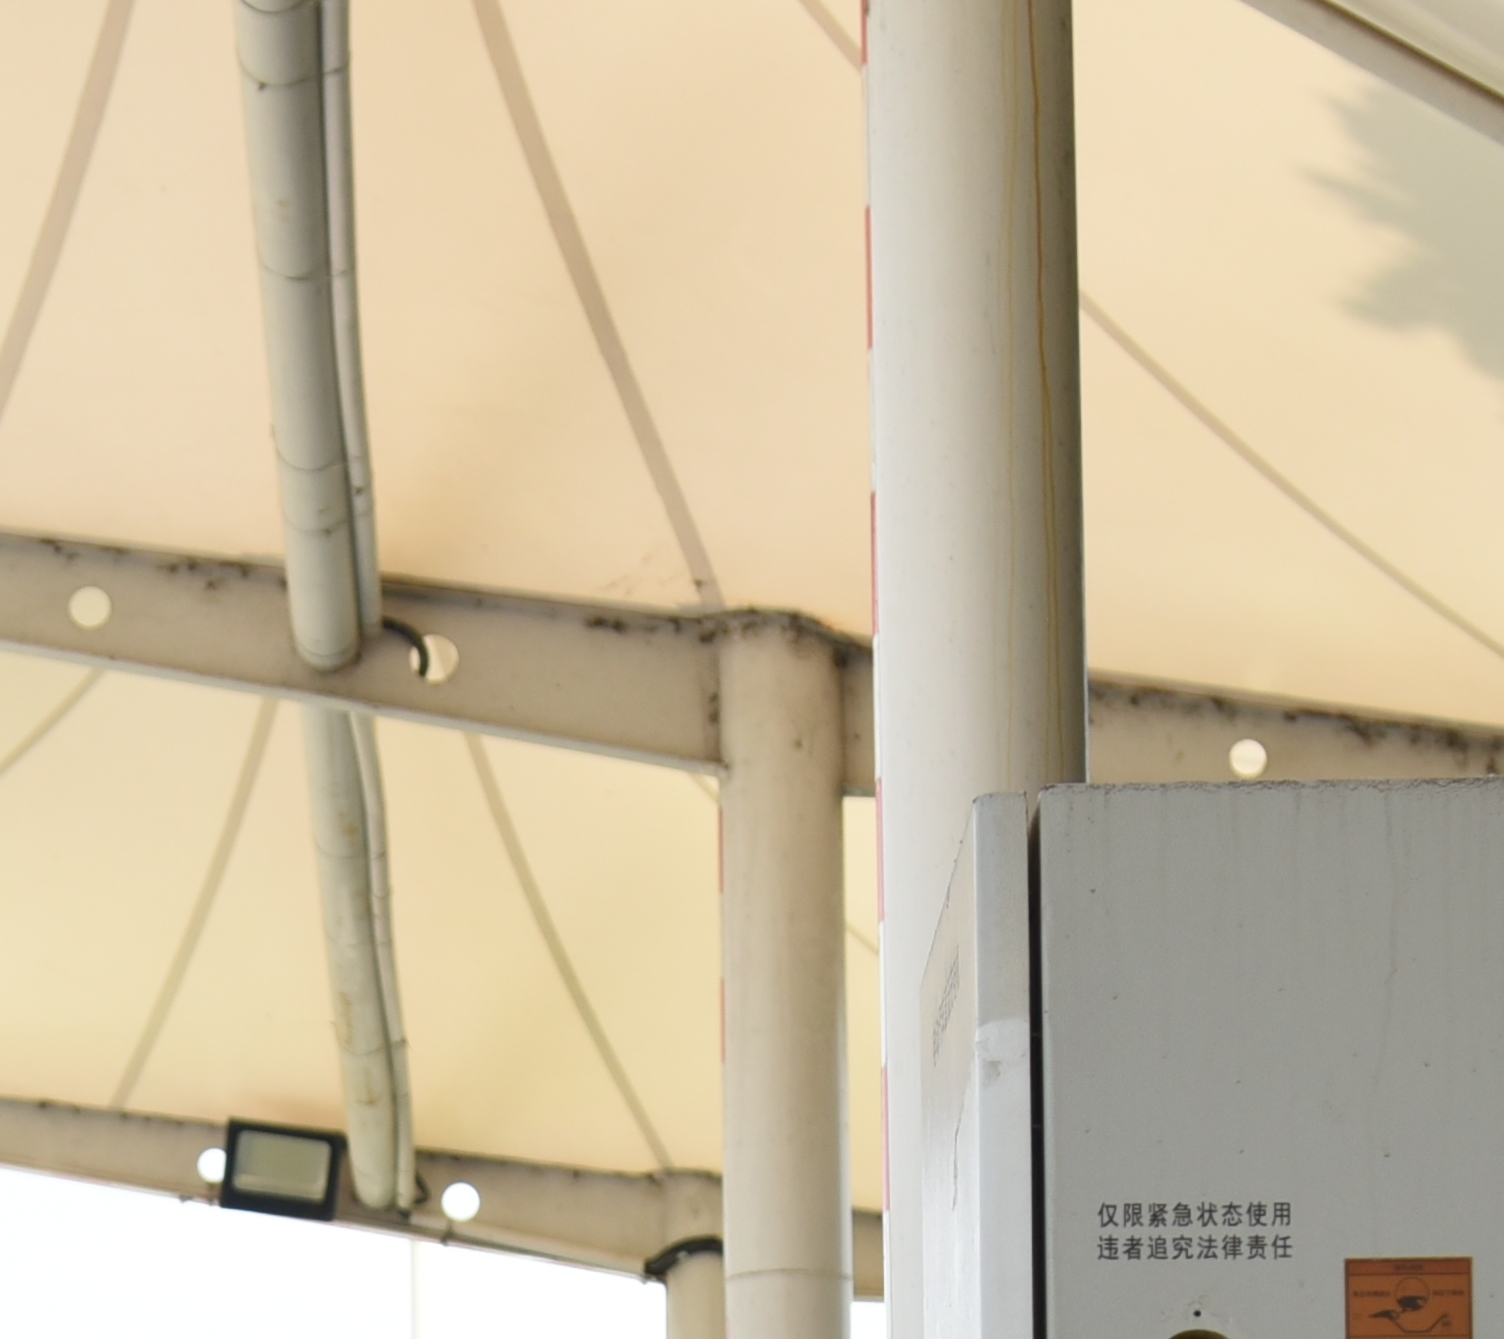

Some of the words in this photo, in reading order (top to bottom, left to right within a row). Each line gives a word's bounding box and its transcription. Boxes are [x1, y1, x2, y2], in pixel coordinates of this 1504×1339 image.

[1097, 1201, 1292, 1228] 仅限紧急状态使用
[1097, 1234, 1294, 1261] 违者追究法律责任
